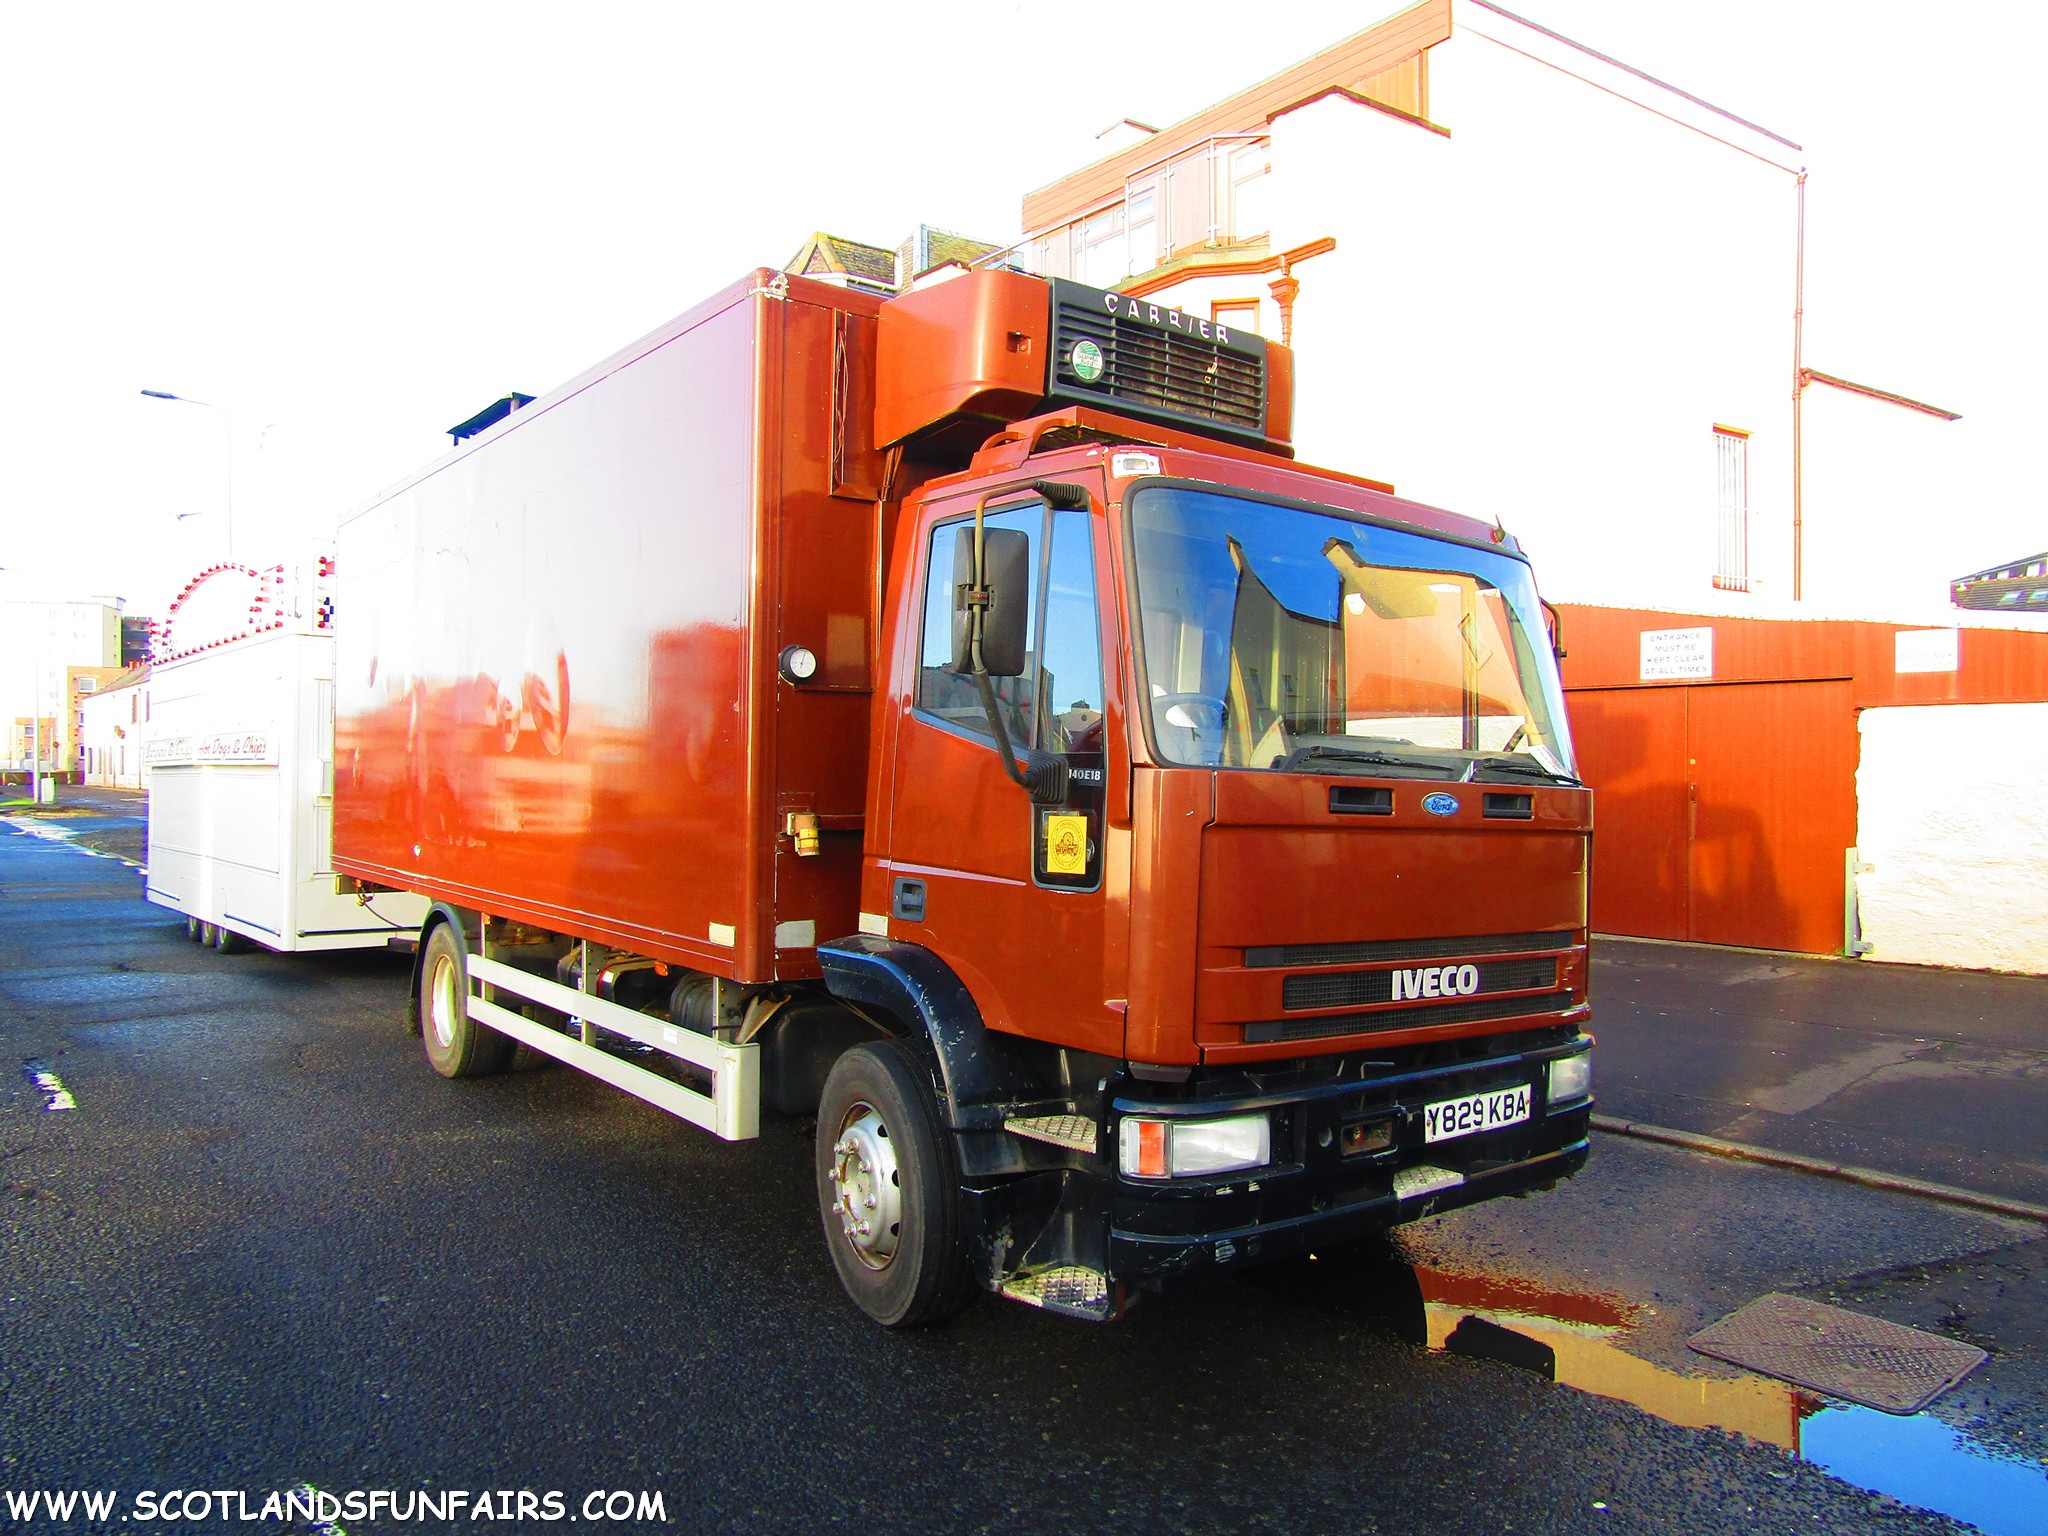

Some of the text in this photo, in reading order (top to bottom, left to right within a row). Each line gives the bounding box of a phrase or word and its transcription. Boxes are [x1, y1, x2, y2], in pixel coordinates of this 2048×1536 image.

[1104, 293, 1229, 344] CARRIER
[1650, 632, 1701, 642] ENTRANCE
[1655, 643, 1697, 652] MUST BE
[1674, 654, 1705, 663] CLEAR
[1679, 665, 1708, 673] TIMES
[199, 735, 267, 760] Hot Dogs & Chips
[1068, 768, 1101, 781] 140E18
[1430, 797, 1454, 812] Ford
[1391, 964, 1479, 1001] IVECO
[1428, 1090, 1526, 1136] Y829 KBA
